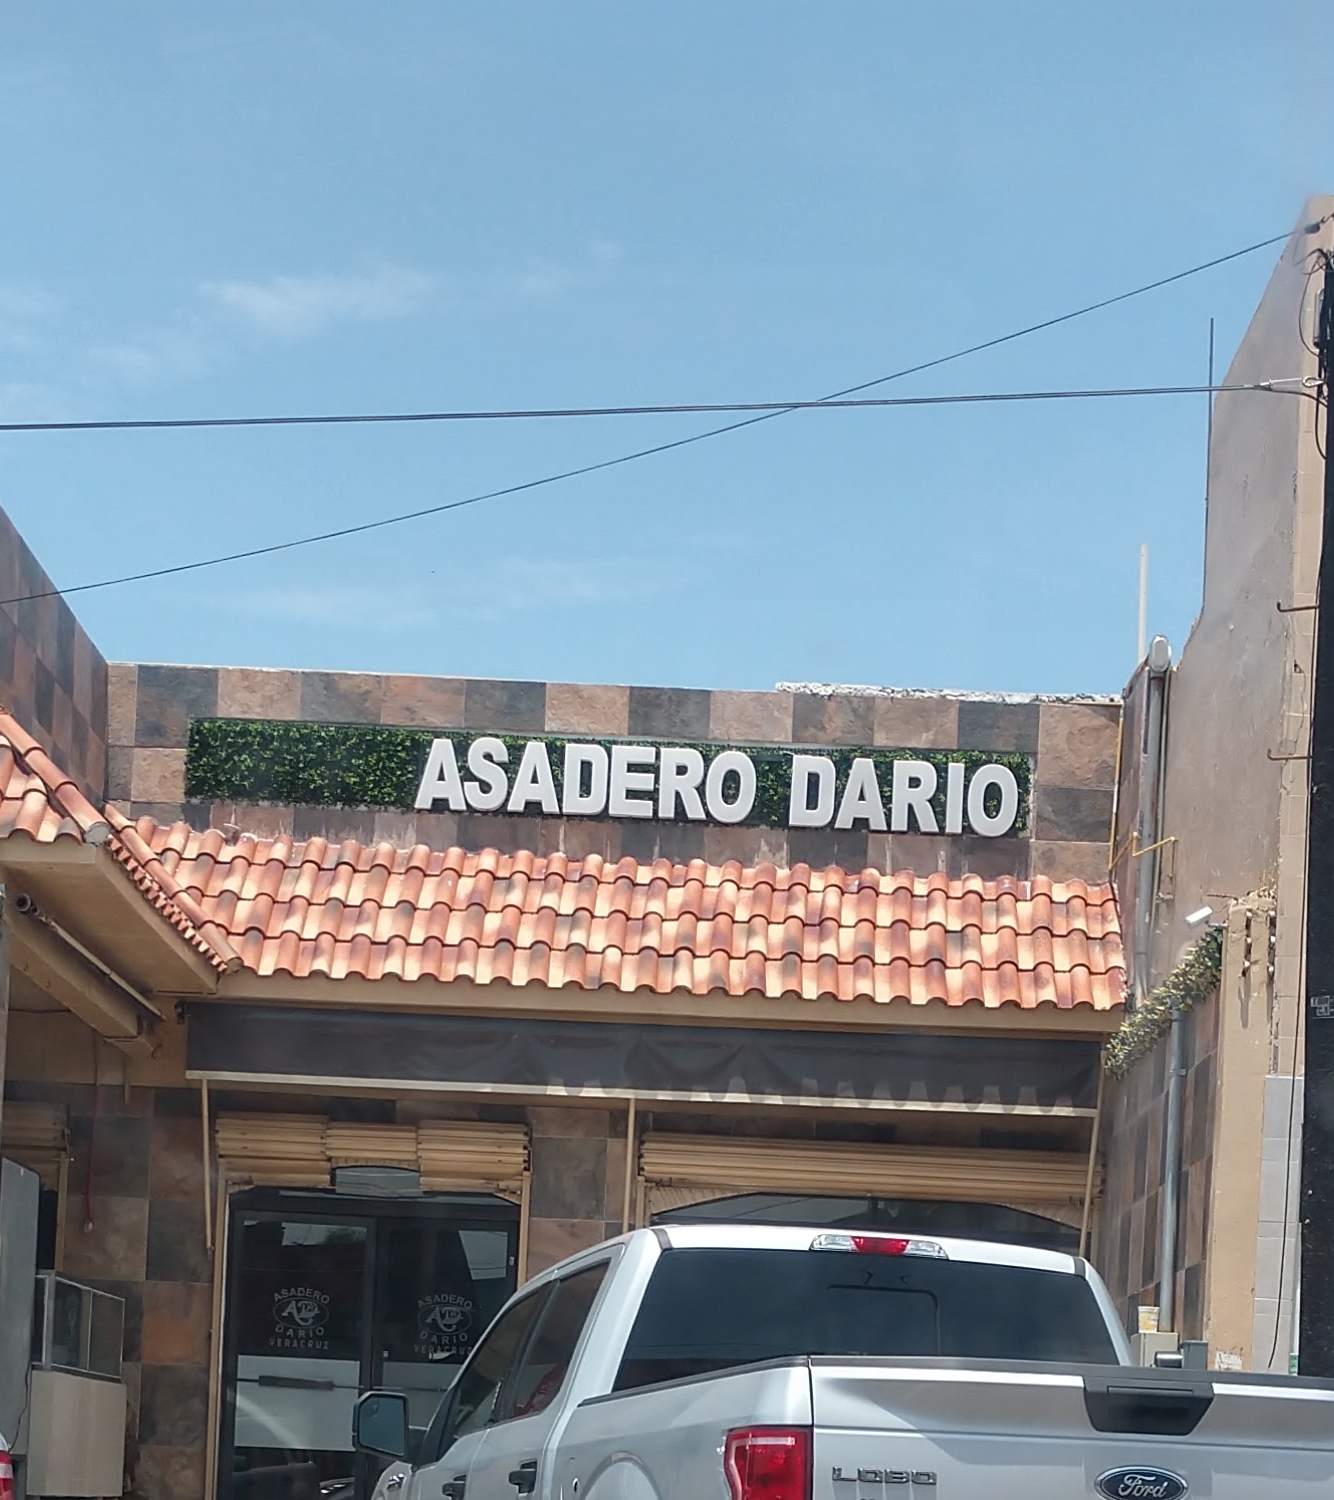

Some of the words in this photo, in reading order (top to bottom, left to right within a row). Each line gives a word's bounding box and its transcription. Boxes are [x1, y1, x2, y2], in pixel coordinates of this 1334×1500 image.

[414, 737, 757, 824] ASADERO
[788, 754, 1018, 838] DARIO
[274, 1287, 330, 1304] ASADERO
[418, 1294, 473, 1310] ASADERO
[275, 1324, 325, 1338] DARIO
[420, 1330, 468, 1345] DARIO
[269, 1338, 330, 1350] VERACRUZ
[832, 1466, 937, 1486] LOBO
[1118, 1474, 1169, 1498] Ford
